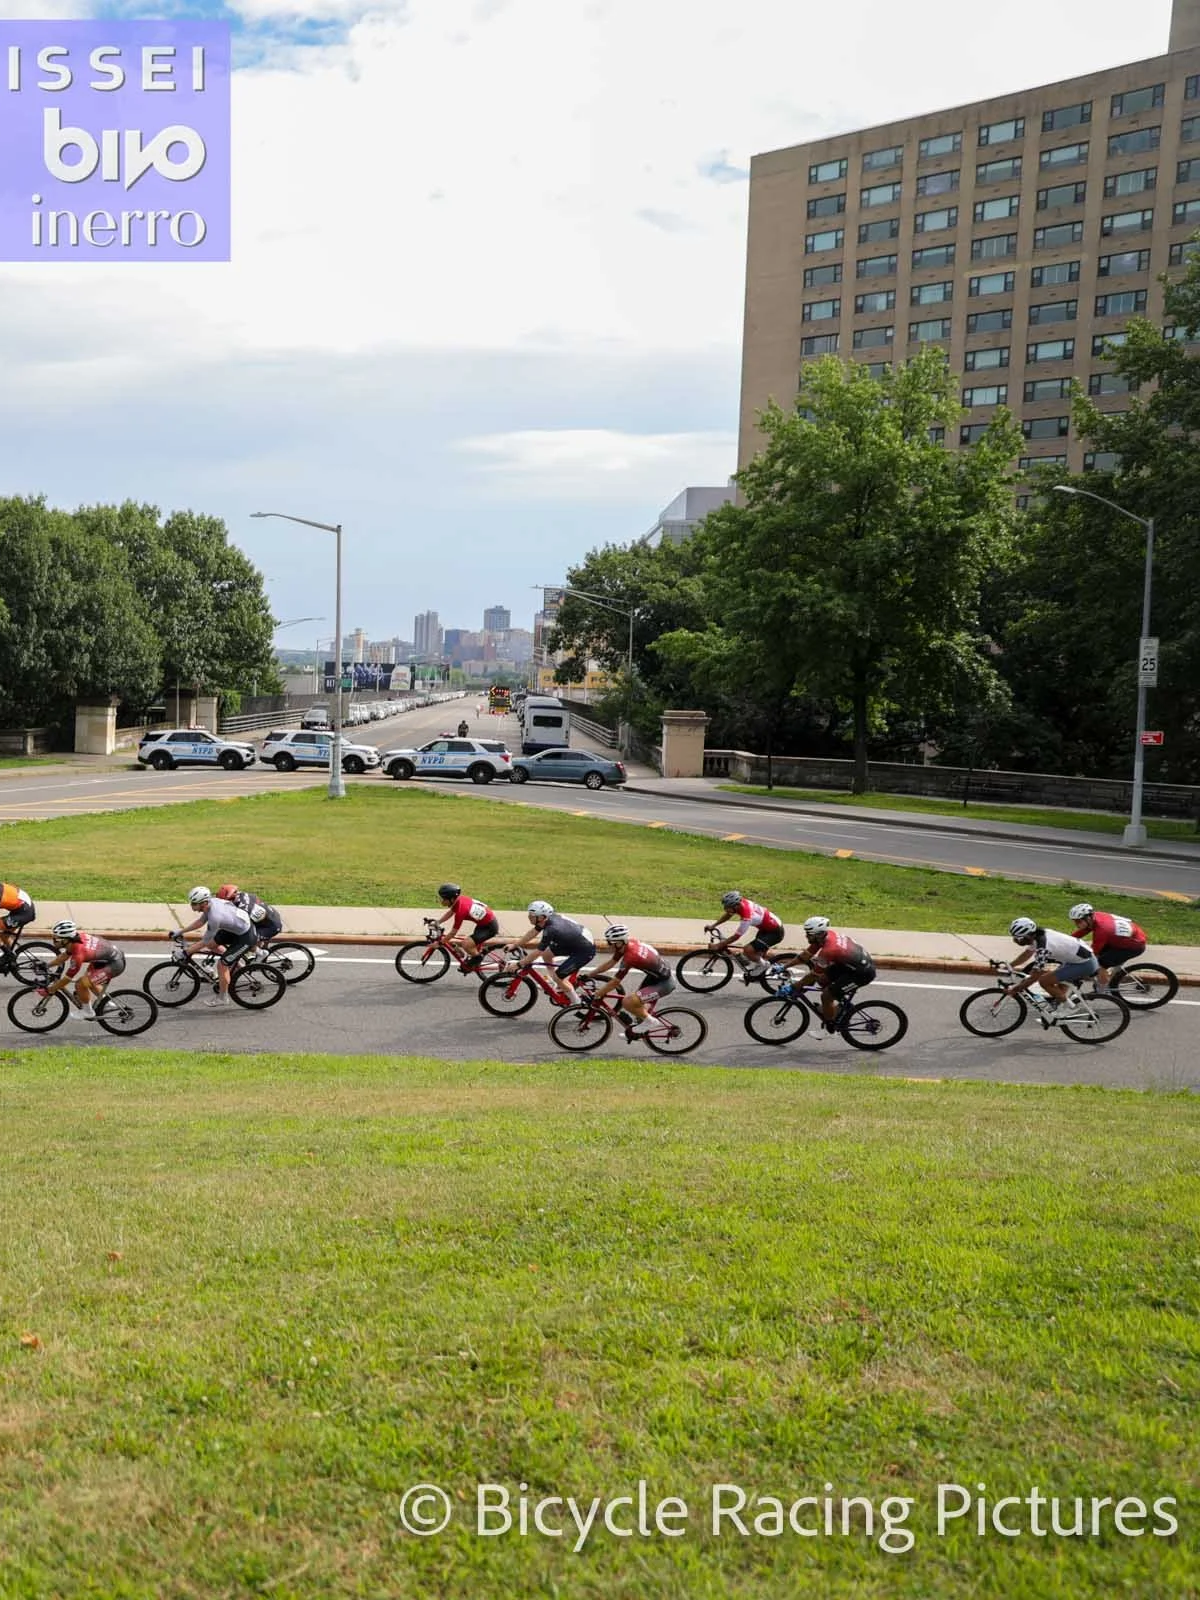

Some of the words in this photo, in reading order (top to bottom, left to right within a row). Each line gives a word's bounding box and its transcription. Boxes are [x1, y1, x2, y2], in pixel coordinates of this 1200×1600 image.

[1142, 657, 1156, 671] 25
[191, 747, 214, 755] NYPD
[421, 756, 446, 765] NYPD
